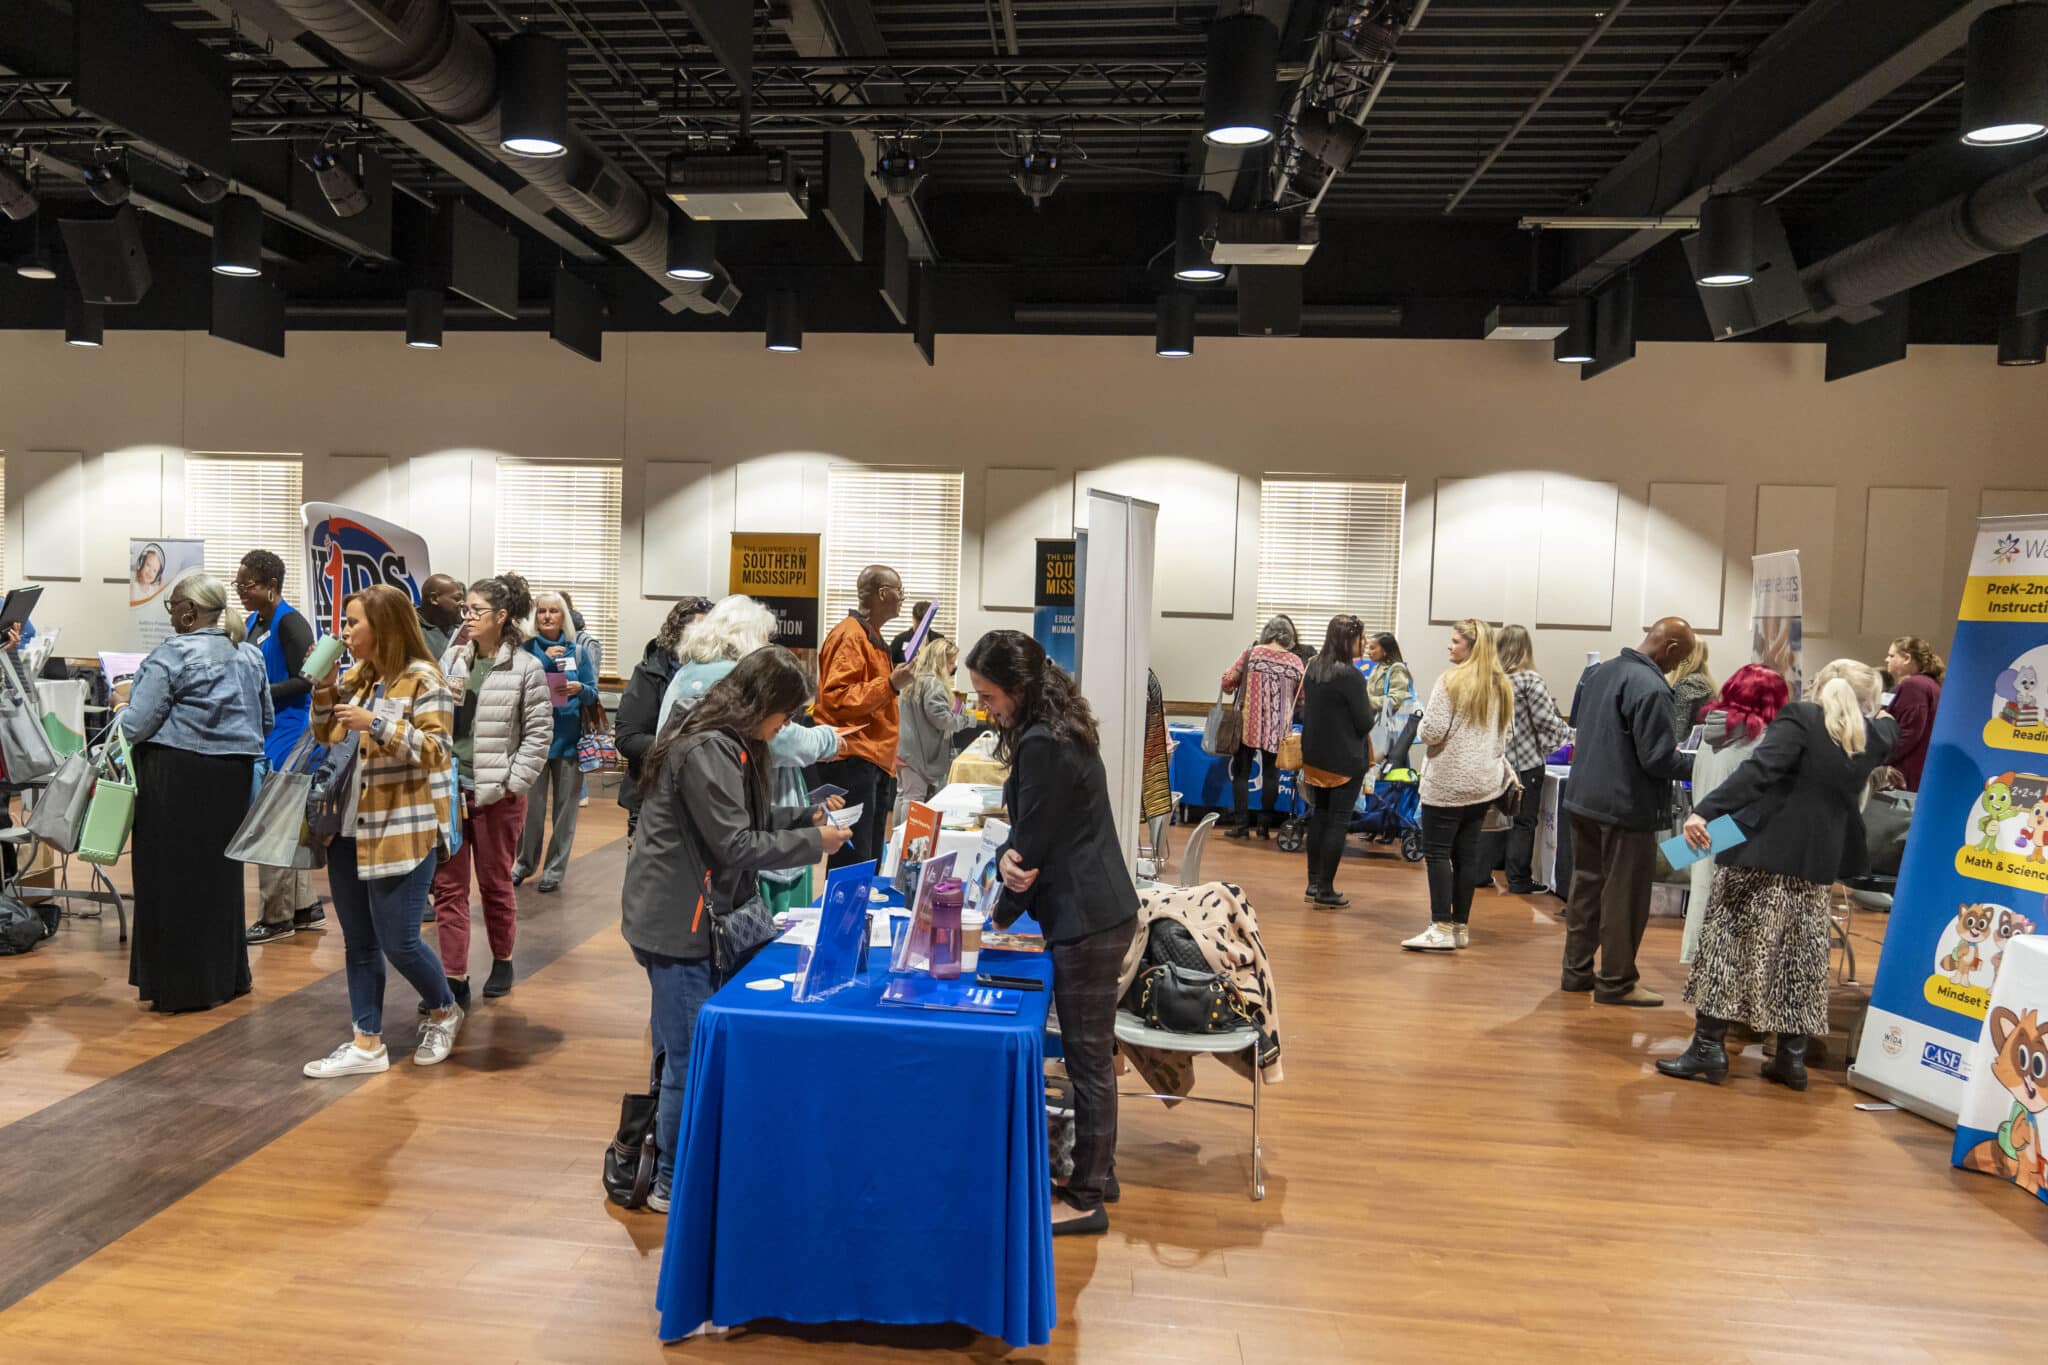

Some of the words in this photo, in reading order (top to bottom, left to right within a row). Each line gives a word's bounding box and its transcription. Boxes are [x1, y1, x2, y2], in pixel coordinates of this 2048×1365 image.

[758, 545, 797, 553] UNIVERSITY
[743, 553, 807, 569] SOUTHERN
[742, 570, 807, 585] MISSISSIPPI
[1046, 561, 1073, 578] SOU
[1046, 580, 1075, 595] MISS
[1965, 855, 1993, 870] Math
[1995, 861, 2004, 872] &
[1937, 985, 1981, 1007] Mindset
[1924, 1044, 1961, 1070] CASE
